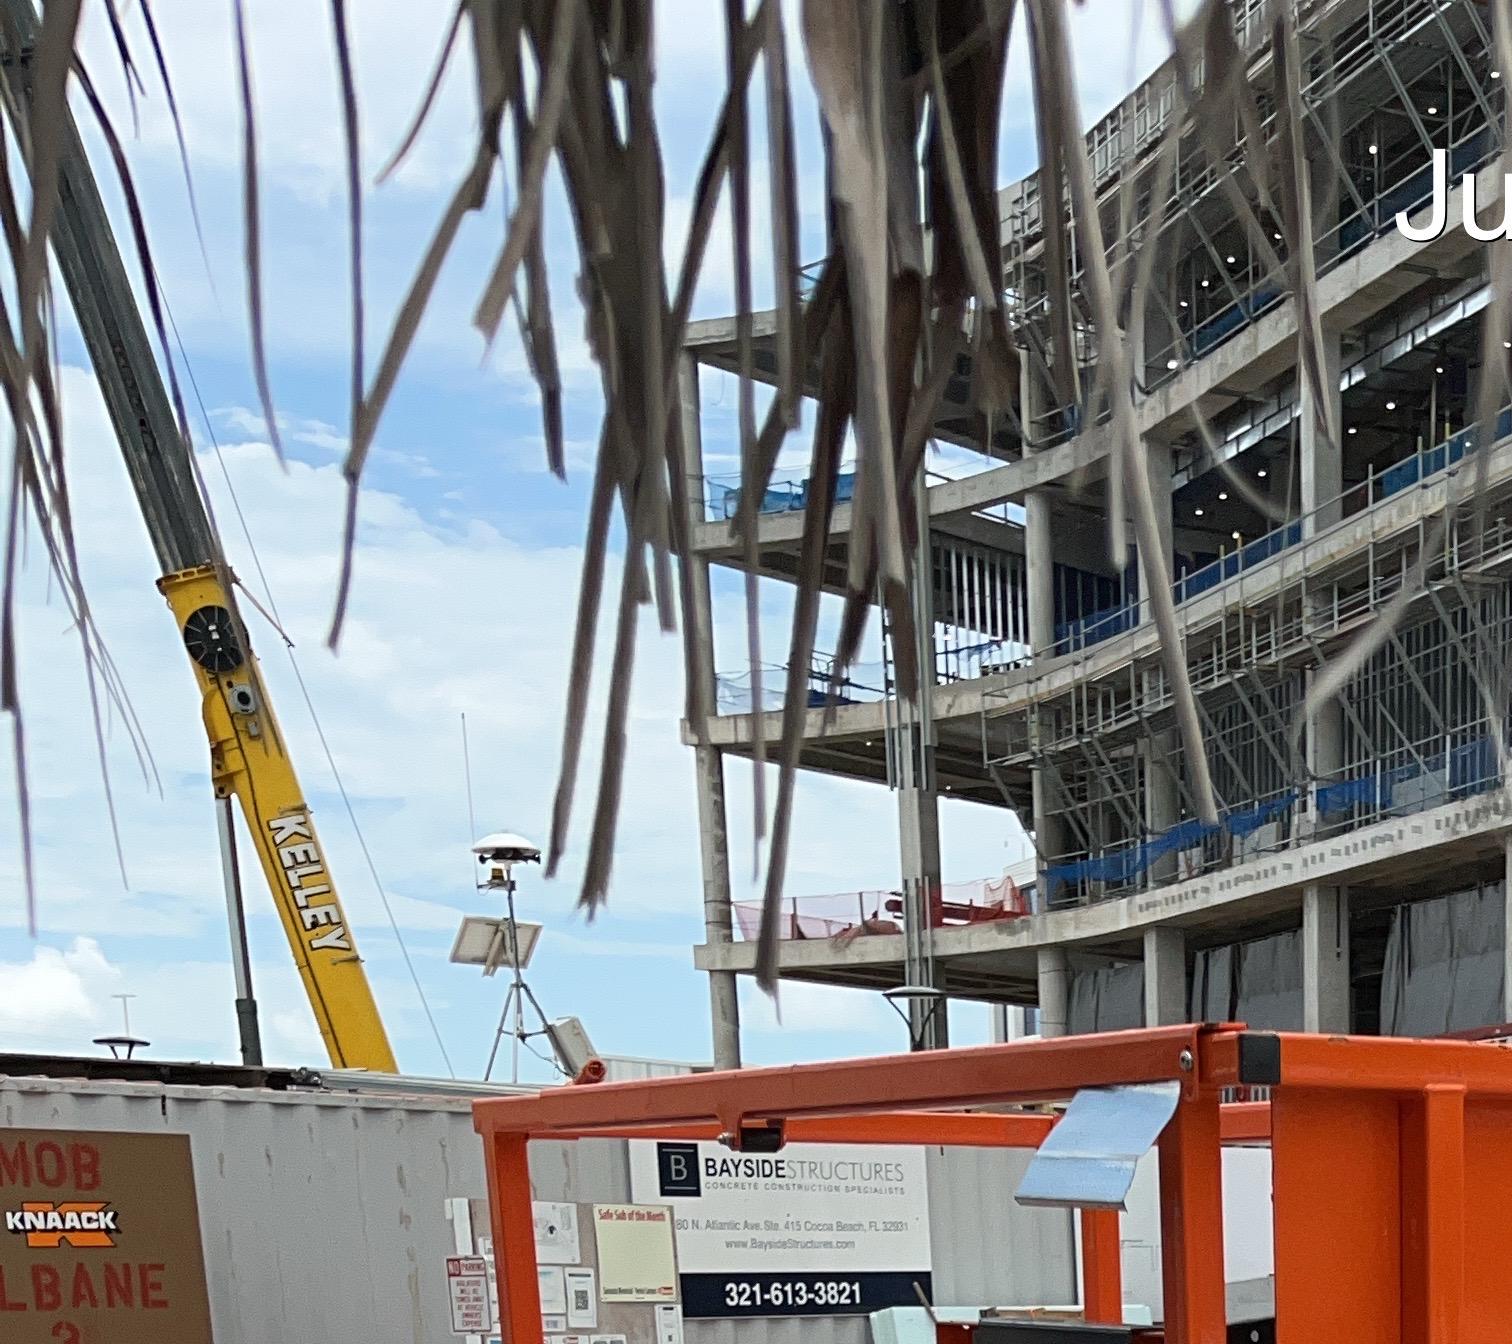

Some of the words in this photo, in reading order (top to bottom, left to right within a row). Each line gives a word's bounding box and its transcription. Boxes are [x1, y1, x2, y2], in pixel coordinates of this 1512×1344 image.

[267, 814, 351, 951] KELLEY
[705, 1181, 759, 1191] CONCRETE
[764, 1183, 841, 1193] CONSTRUCTION
[844, 1185, 906, 1196] SPECIALISTS
[5, 1210, 120, 1234] KNAACK
[704, 1218, 740, 1231] Atlantic
[784, 1220, 801, 1232] 415
[804, 1220, 834, 1232] Cocoa
[868, 1221, 880, 1232] FL
[724, 1281, 862, 1307] 321-613-3821
